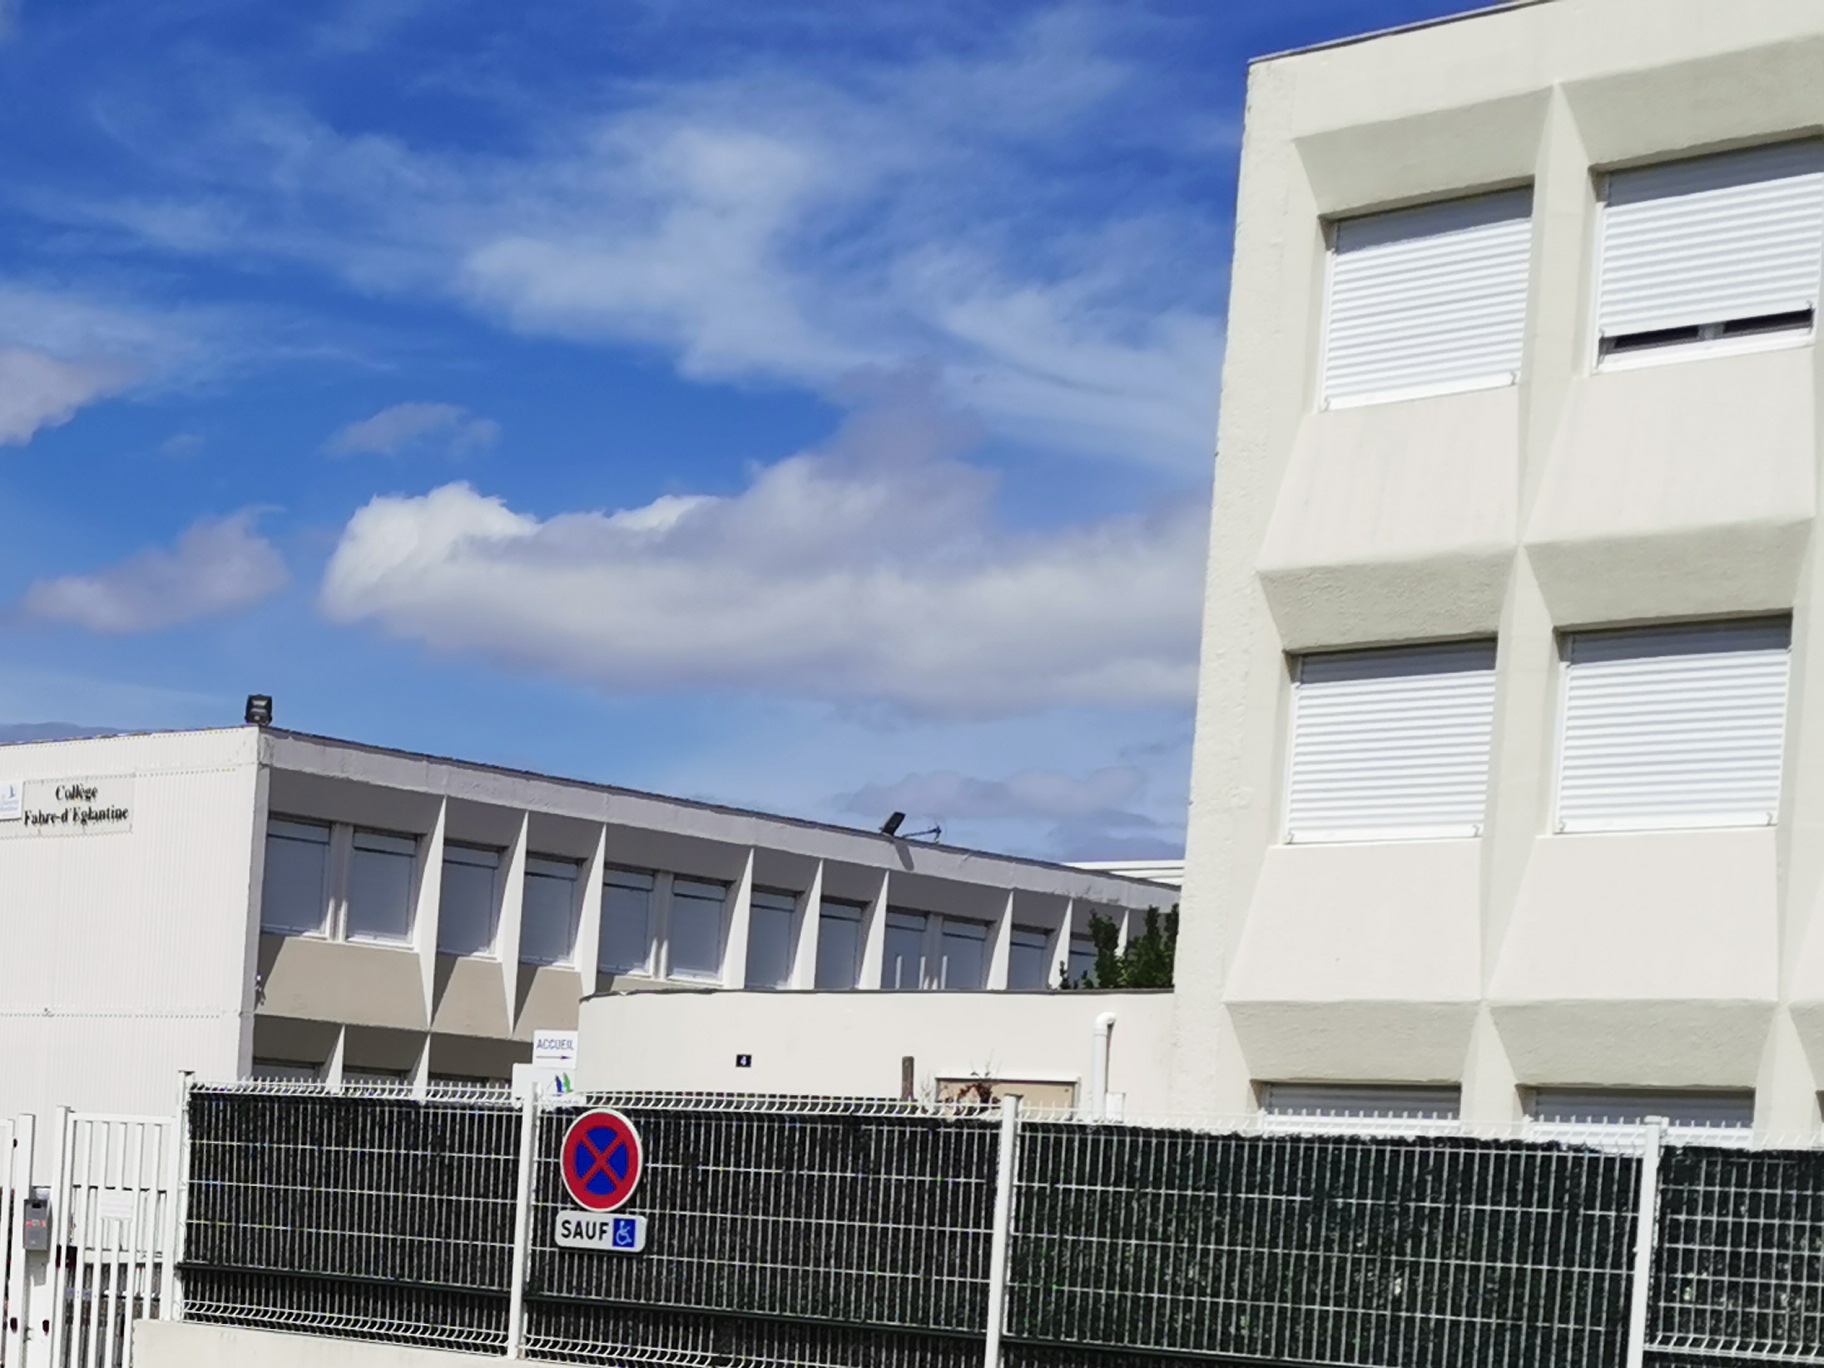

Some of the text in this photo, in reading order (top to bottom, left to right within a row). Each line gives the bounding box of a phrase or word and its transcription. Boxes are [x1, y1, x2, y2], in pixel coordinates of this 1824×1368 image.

[55, 783, 98, 802] Collège
[536, 1038, 574, 1051] ACCUEIL
[561, 1219, 609, 1241] SAUF
